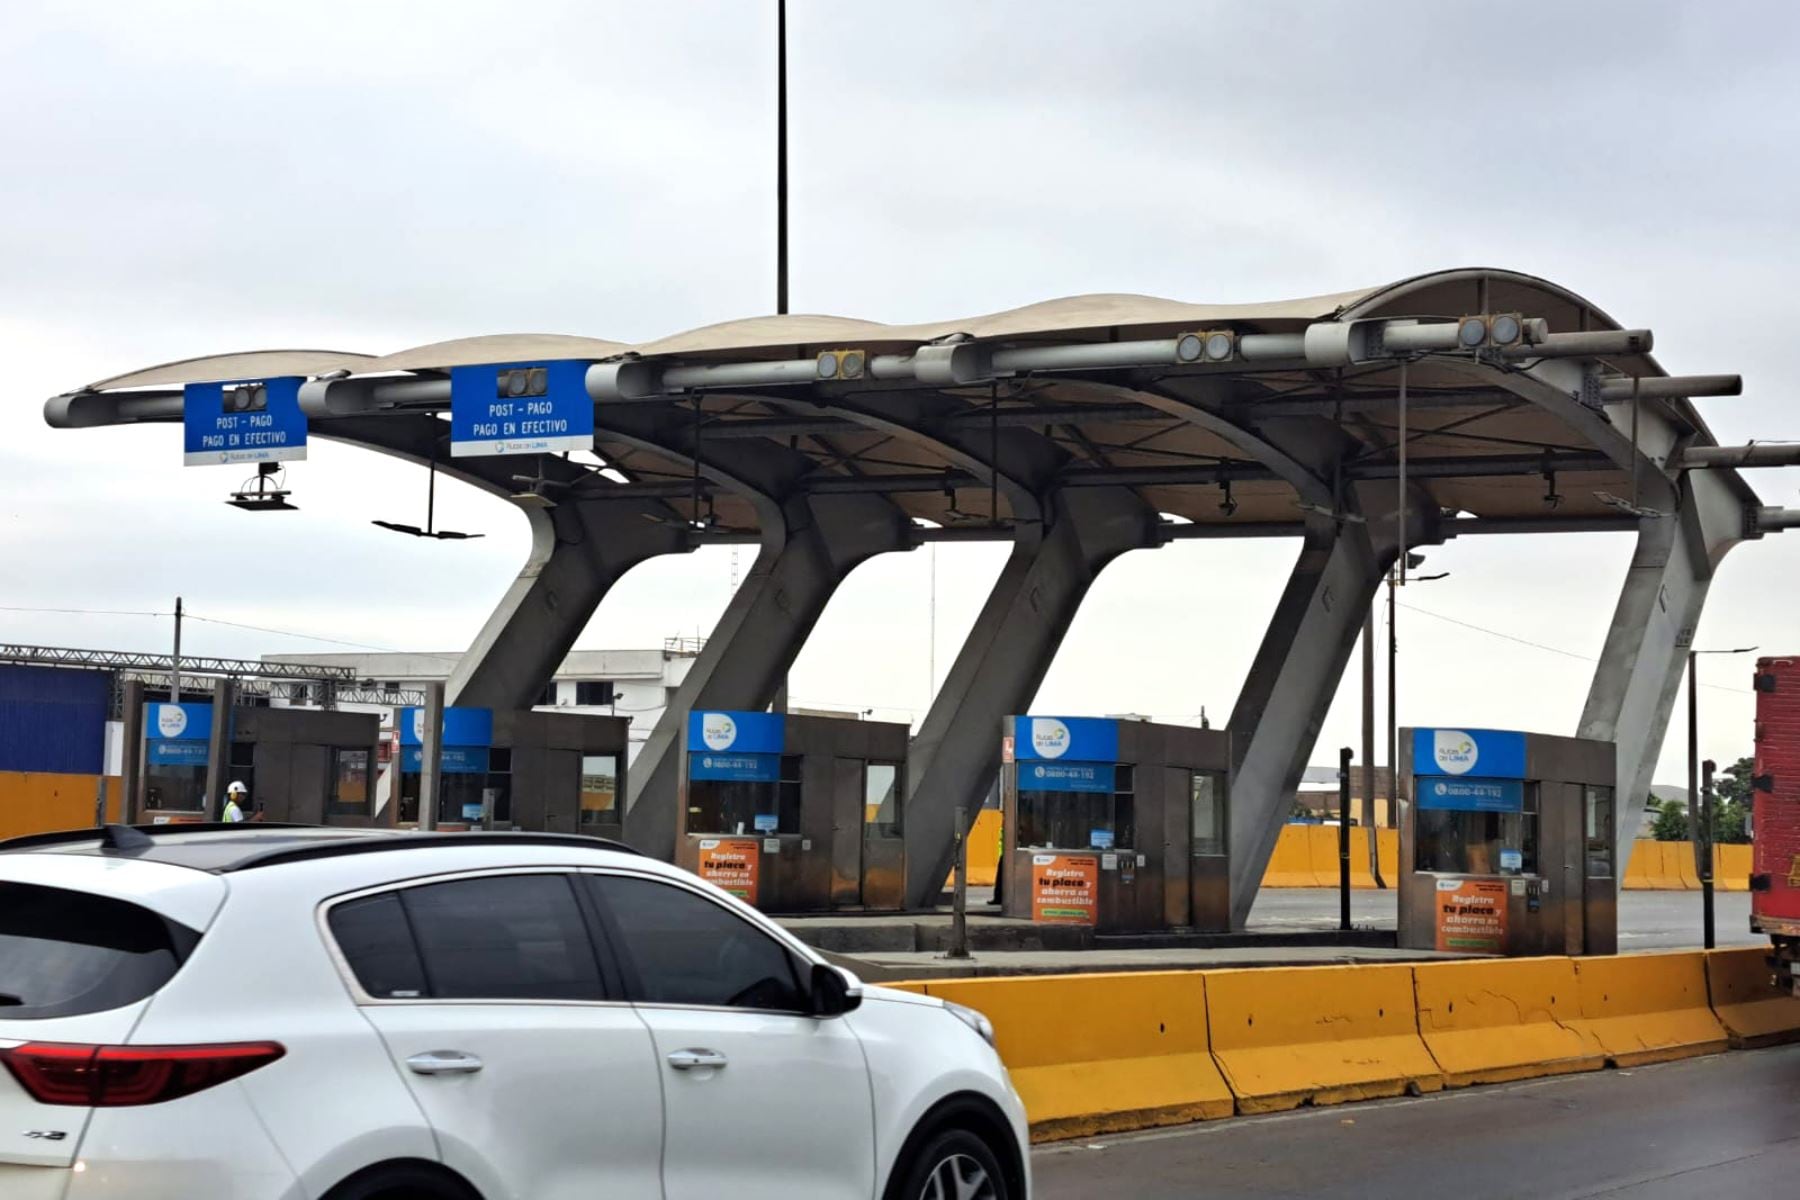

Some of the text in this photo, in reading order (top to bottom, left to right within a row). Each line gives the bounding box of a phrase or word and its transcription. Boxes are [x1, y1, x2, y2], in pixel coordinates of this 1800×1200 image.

[489, 403, 514, 417] POST
[527, 401, 552, 415] PAGO
[216, 417, 238, 429] POST
[250, 414, 272, 427] PAGO
[473, 419, 567, 436] PAGO EN EFECTIVO
[202, 431, 286, 447] PAGO EN EFECTIVO
[1039, 878, 1050, 886] tu
[1443, 905, 1456, 913] tu
